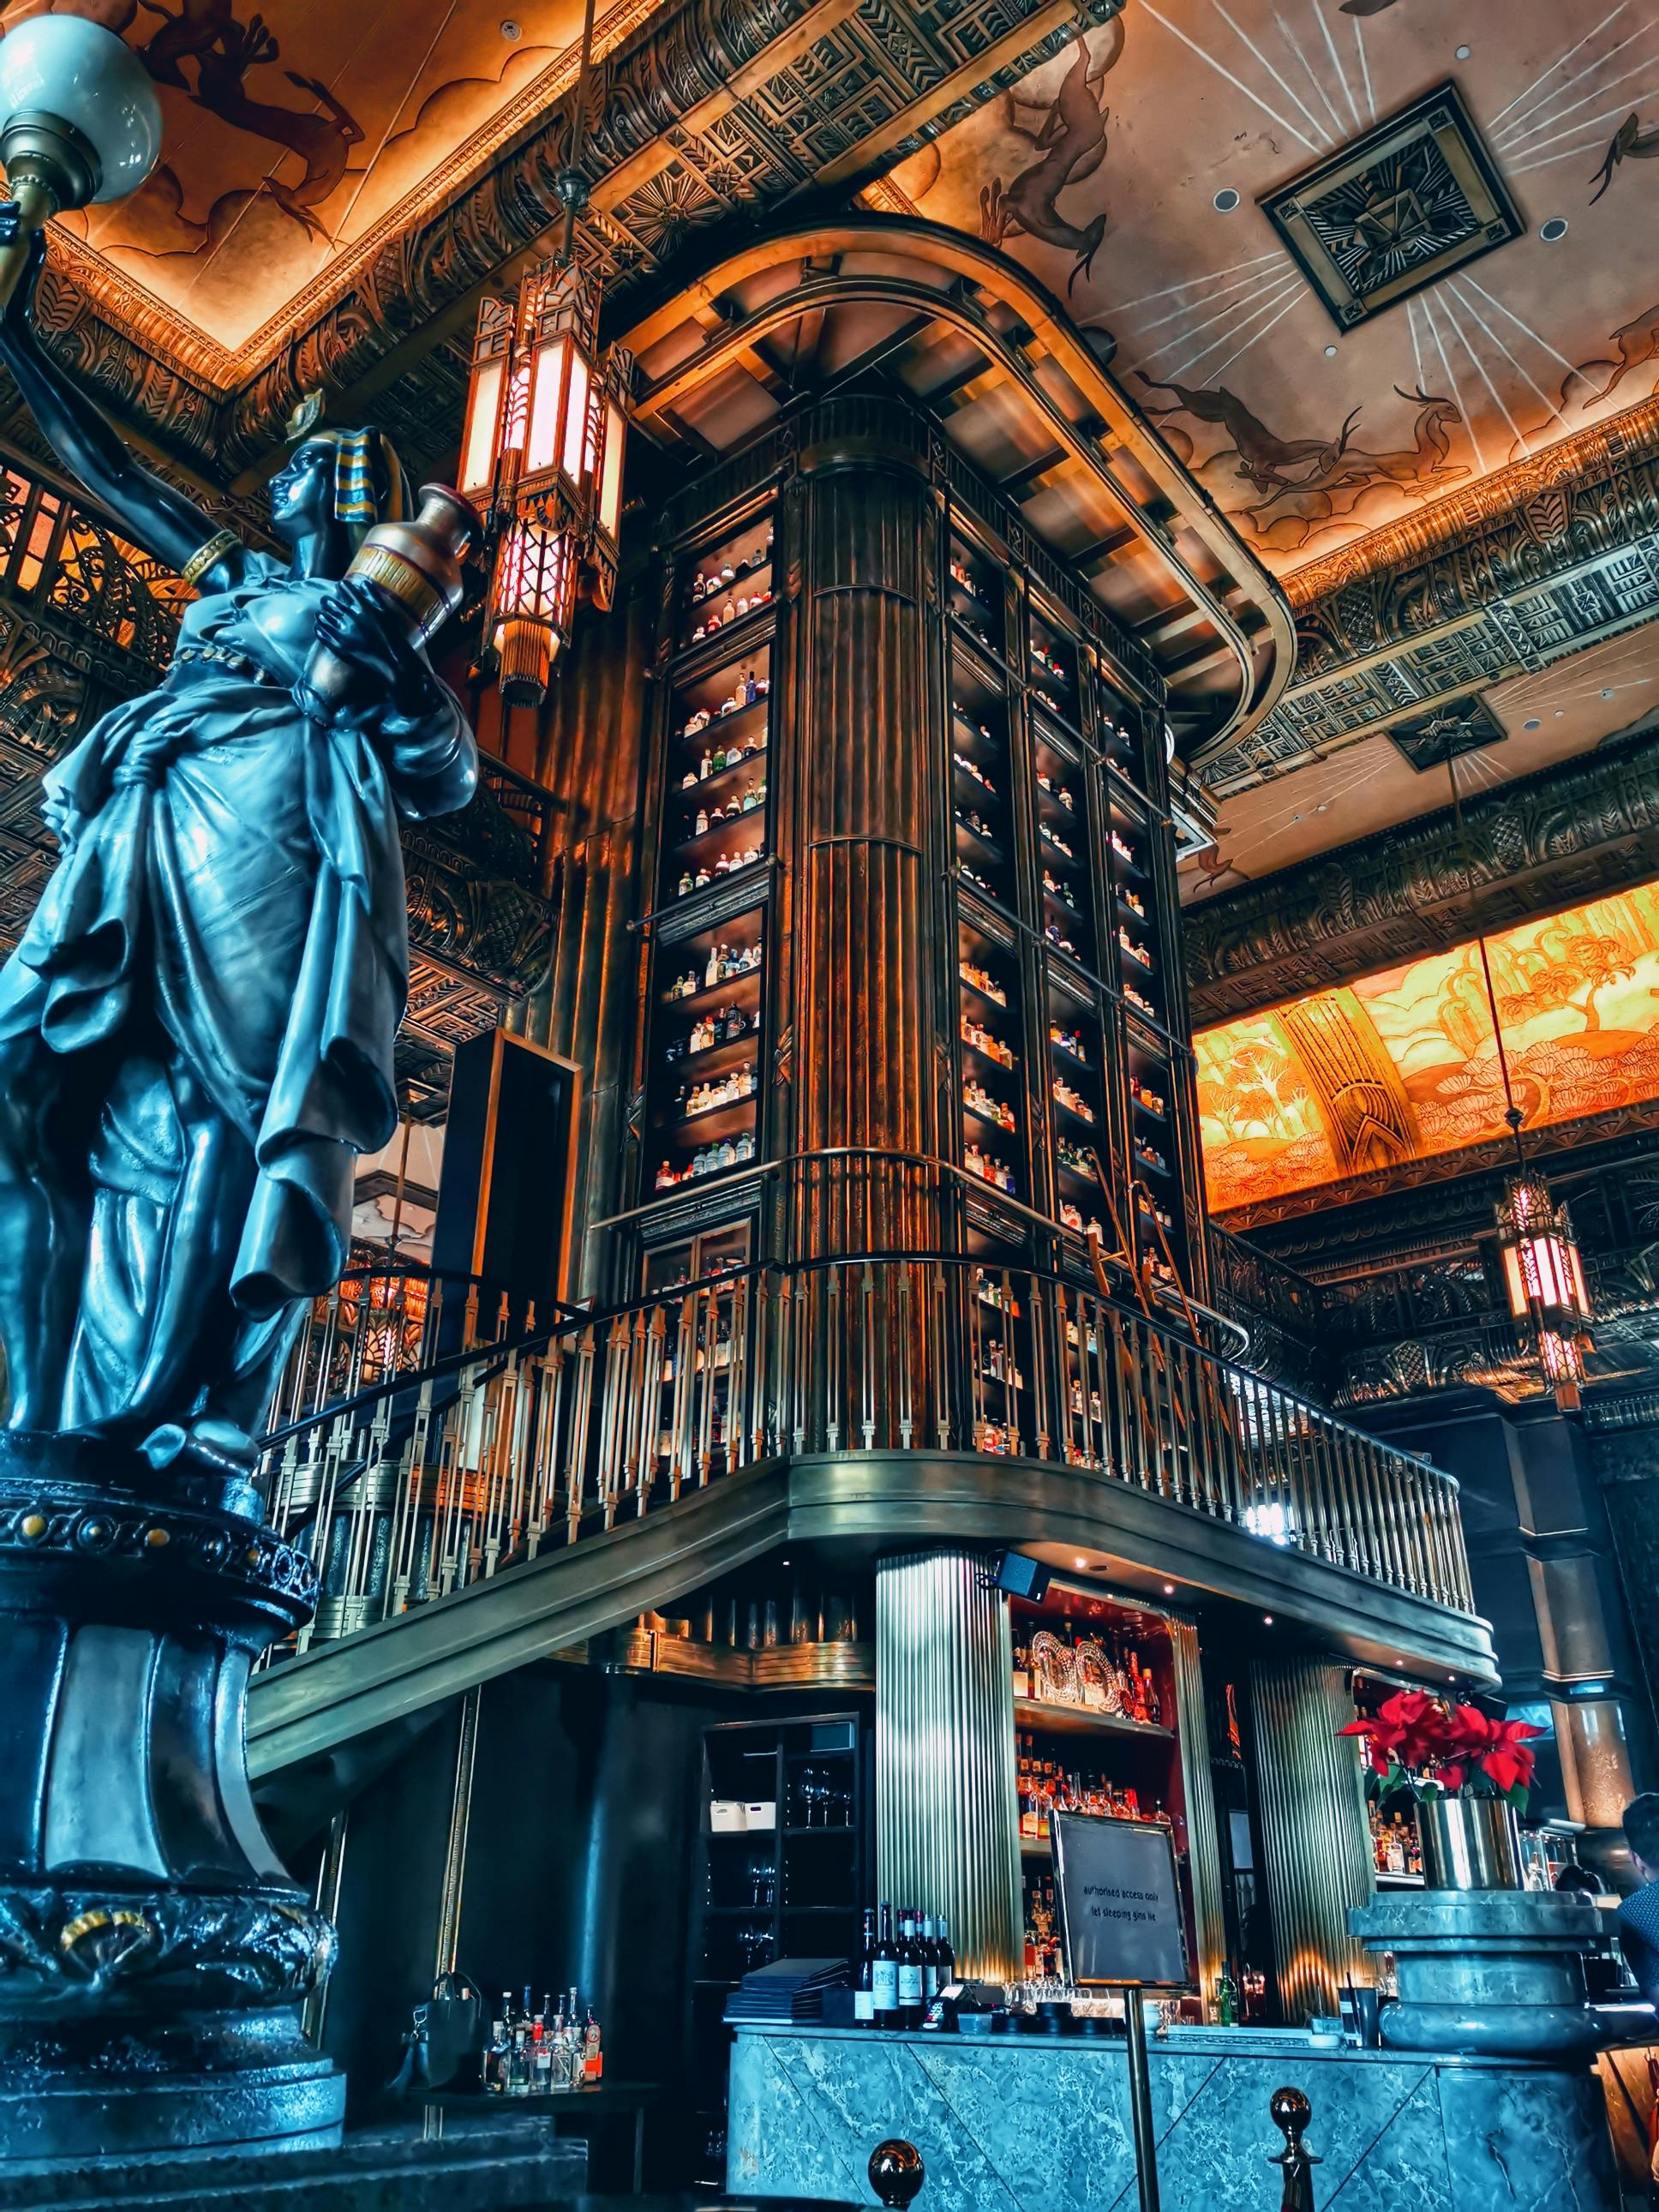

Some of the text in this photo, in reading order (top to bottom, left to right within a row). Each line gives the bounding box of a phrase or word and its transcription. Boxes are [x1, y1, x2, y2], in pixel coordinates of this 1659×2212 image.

[1083, 1885, 1159, 1902] authorised access only
[1091, 1906, 1157, 1921] let sleeping gins lie
